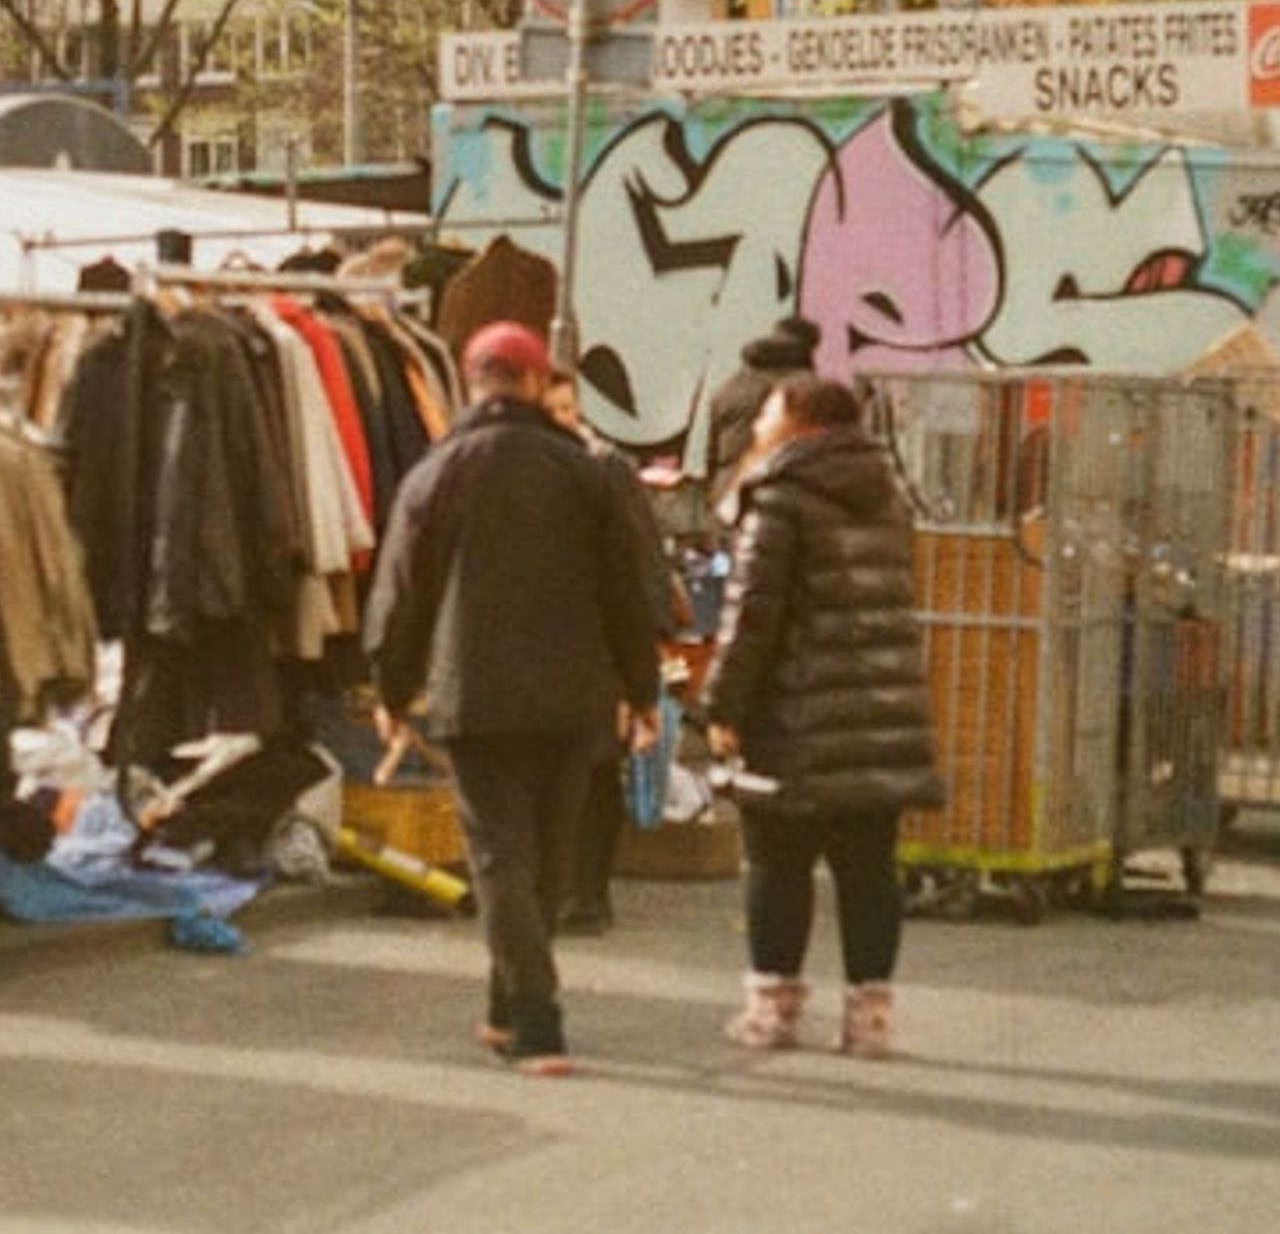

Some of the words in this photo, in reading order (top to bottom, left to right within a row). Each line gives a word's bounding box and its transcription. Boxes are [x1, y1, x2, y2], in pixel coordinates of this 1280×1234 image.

[656, 31, 762, 78] OODJES
[1070, 14, 1158, 59] PATATES
[1165, 12, 1238, 56] FRITES
[1034, 63, 1180, 112] SNACKS
